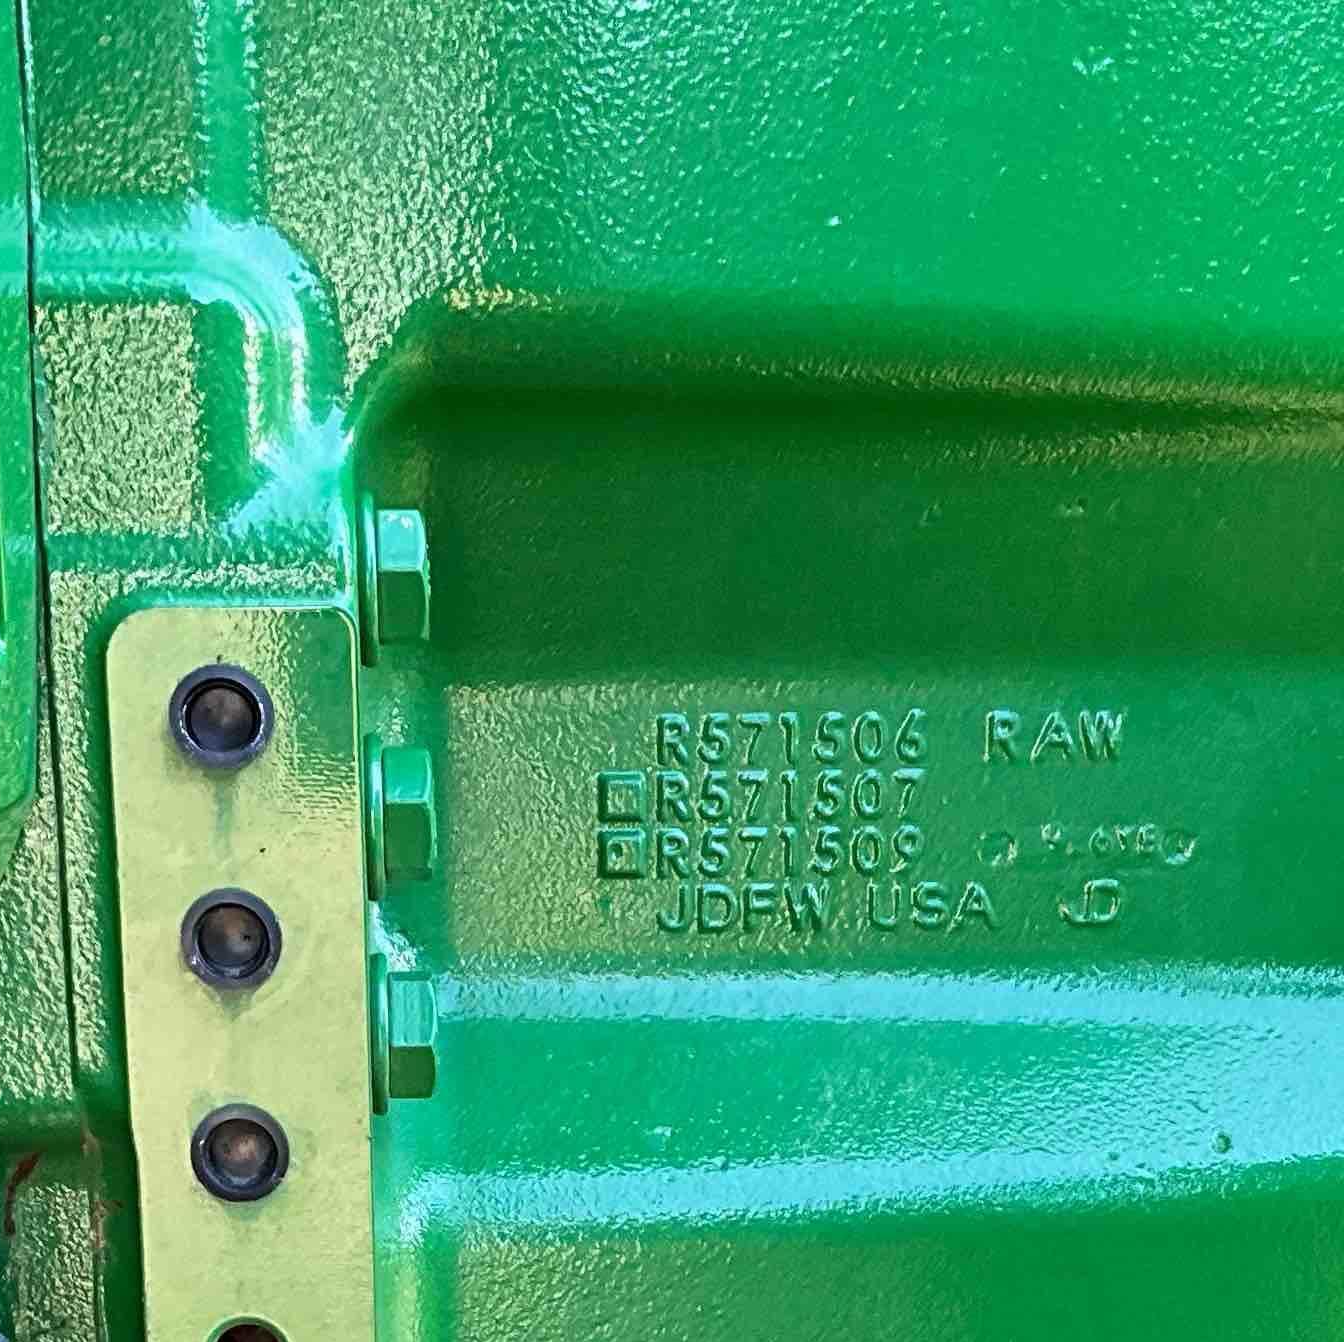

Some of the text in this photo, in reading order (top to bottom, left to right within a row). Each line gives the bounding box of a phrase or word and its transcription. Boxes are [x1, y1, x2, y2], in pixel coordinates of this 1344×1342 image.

[656, 708, 1126, 765] R571506 RAW
[656, 768, 926, 822] R571507
[656, 823, 923, 879] R571509
[656, 880, 830, 934] JDFW
[865, 879, 999, 933] USA
